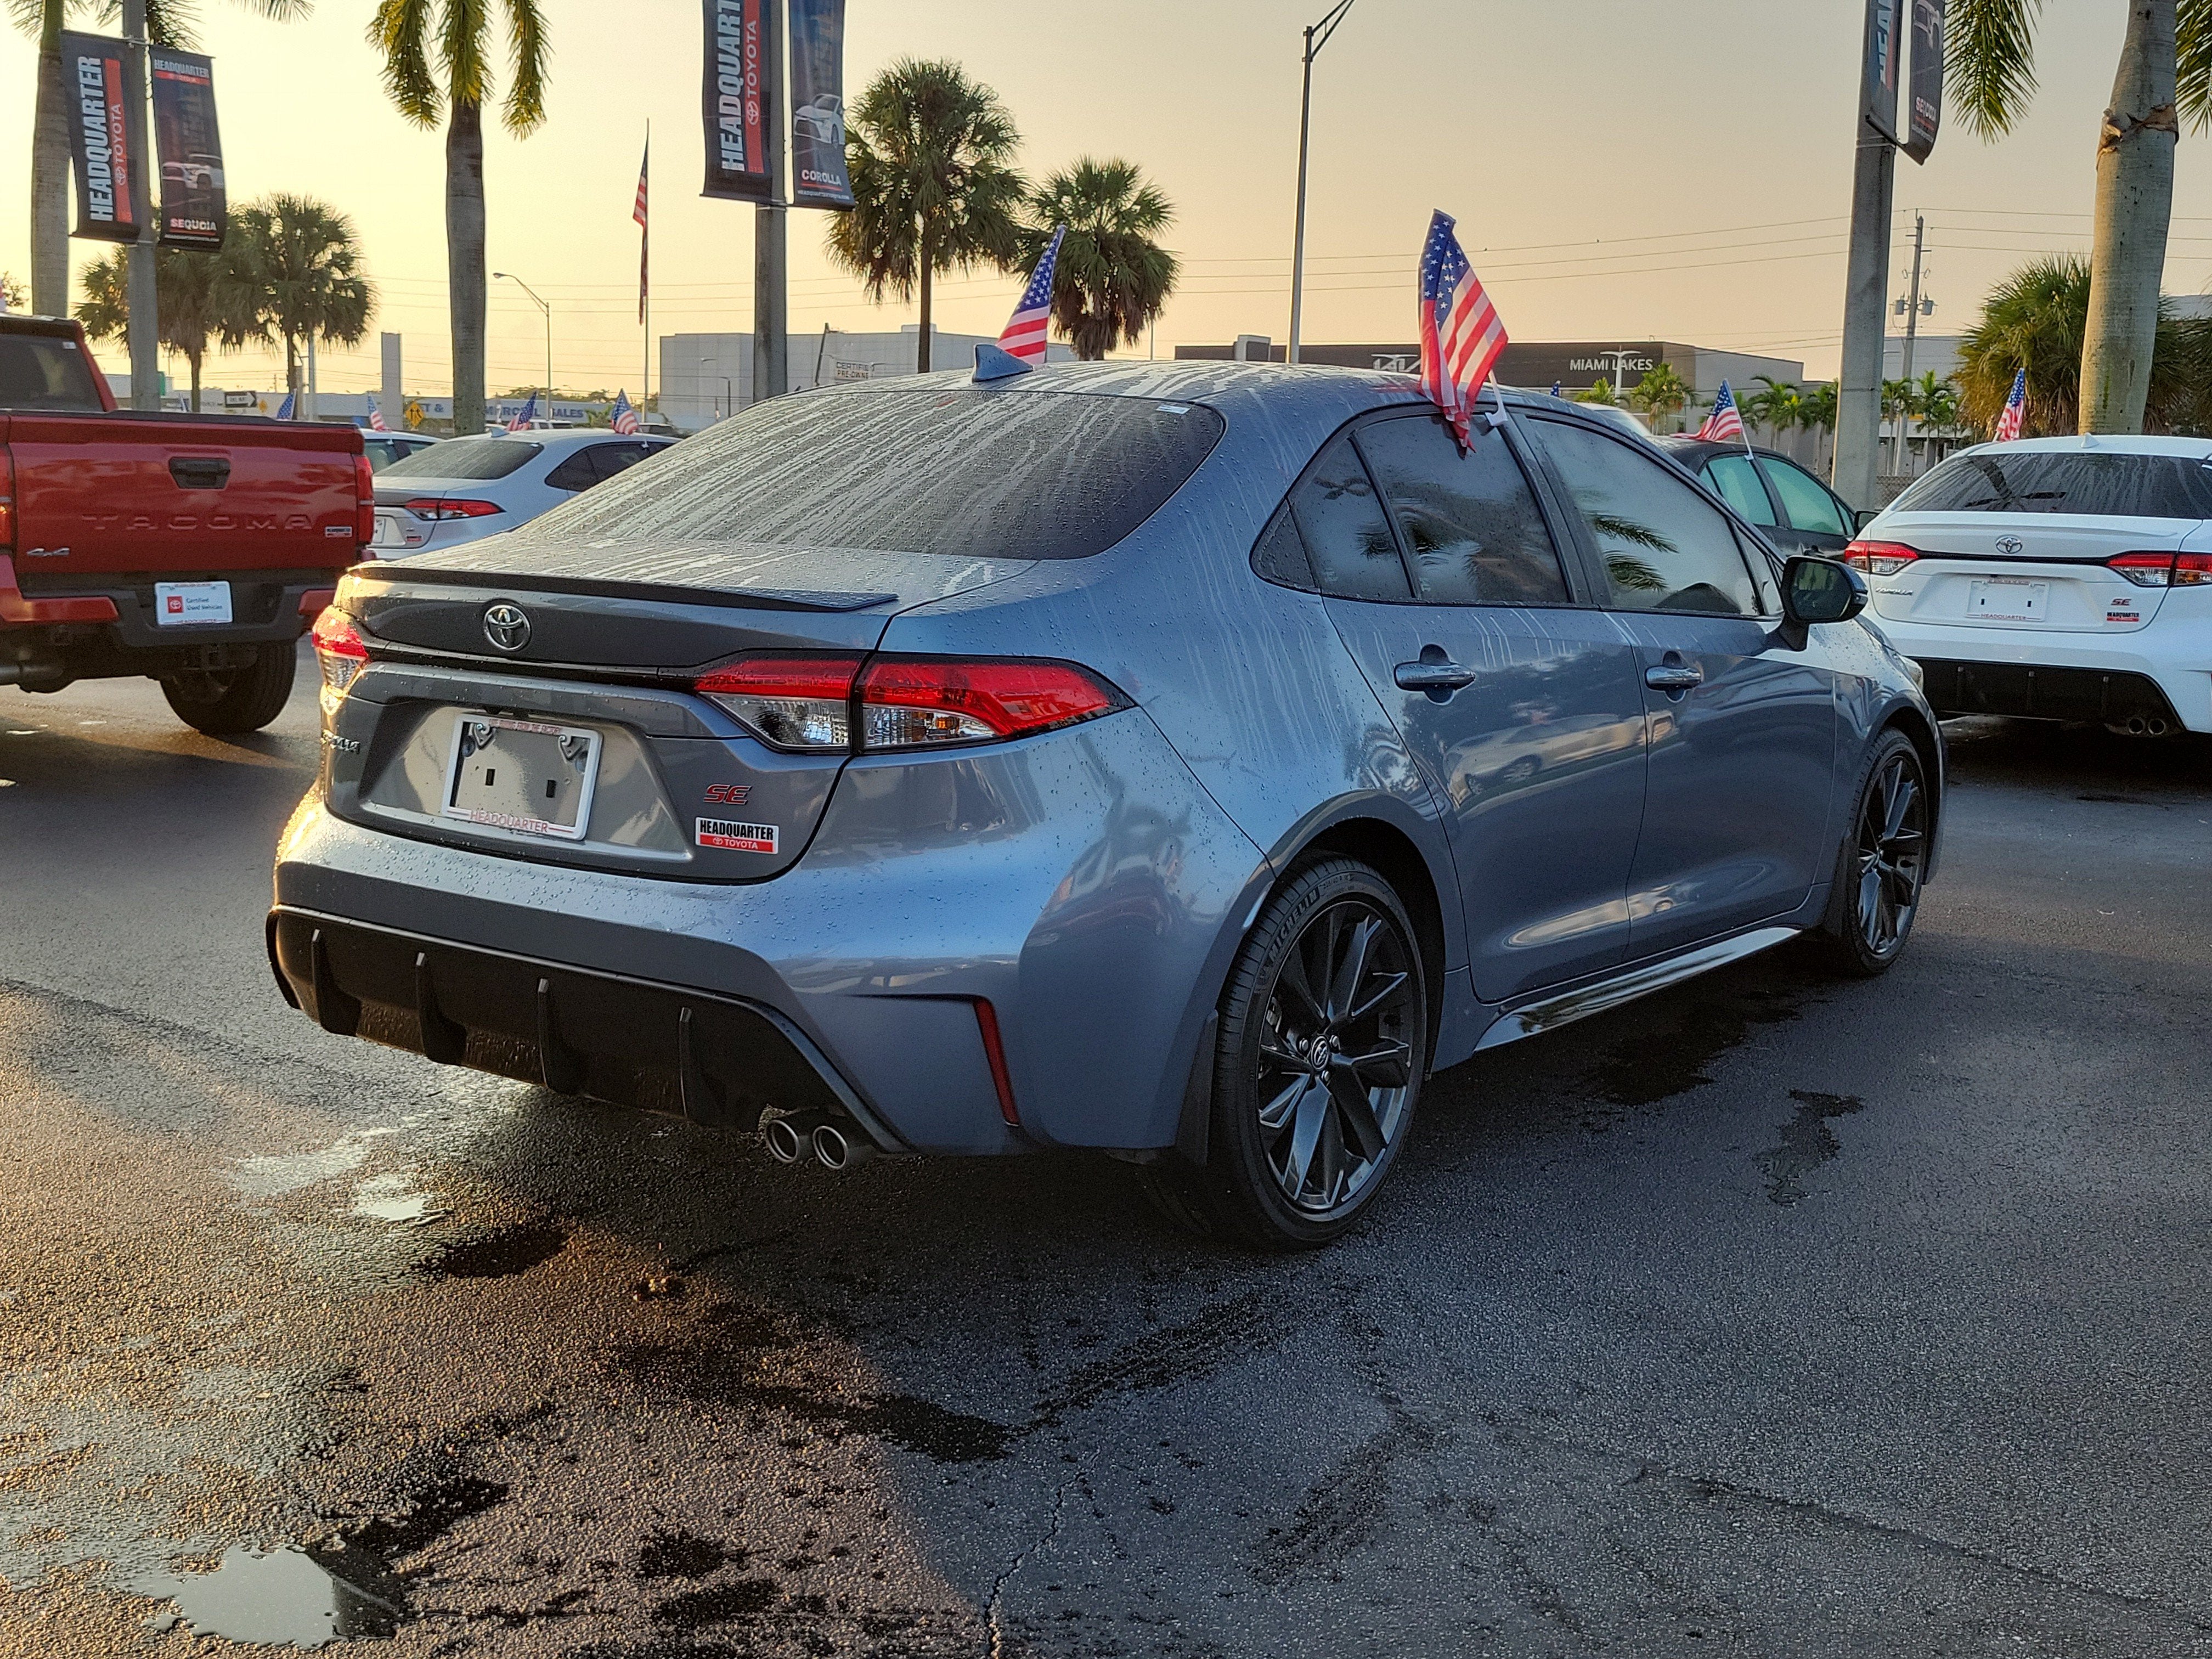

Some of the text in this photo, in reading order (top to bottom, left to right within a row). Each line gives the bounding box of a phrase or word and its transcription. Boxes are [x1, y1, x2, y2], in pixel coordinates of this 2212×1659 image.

[747, 20, 758, 99] TOYOTA
[78, 57, 113, 222] HEADQUARTER
[110, 104, 124, 163] TOYOTA
[802, 170, 842, 186] COROLLA
[170, 218, 217, 230] SEQUOIA
[837, 362, 869, 371] CERTIFIE
[1570, 358, 1654, 371] MIAMI LAKES
[837, 370, 869, 379] PRE-OWNE
[81, 514, 313, 531] TACOMA
[703, 784, 753, 805] SE
[470, 809, 549, 833] HEADQUARTER
[700, 820, 774, 840] HEADQUARTER
[724, 838, 759, 850] TOYOTA
[1268, 888, 1320, 963] MICHELIN
